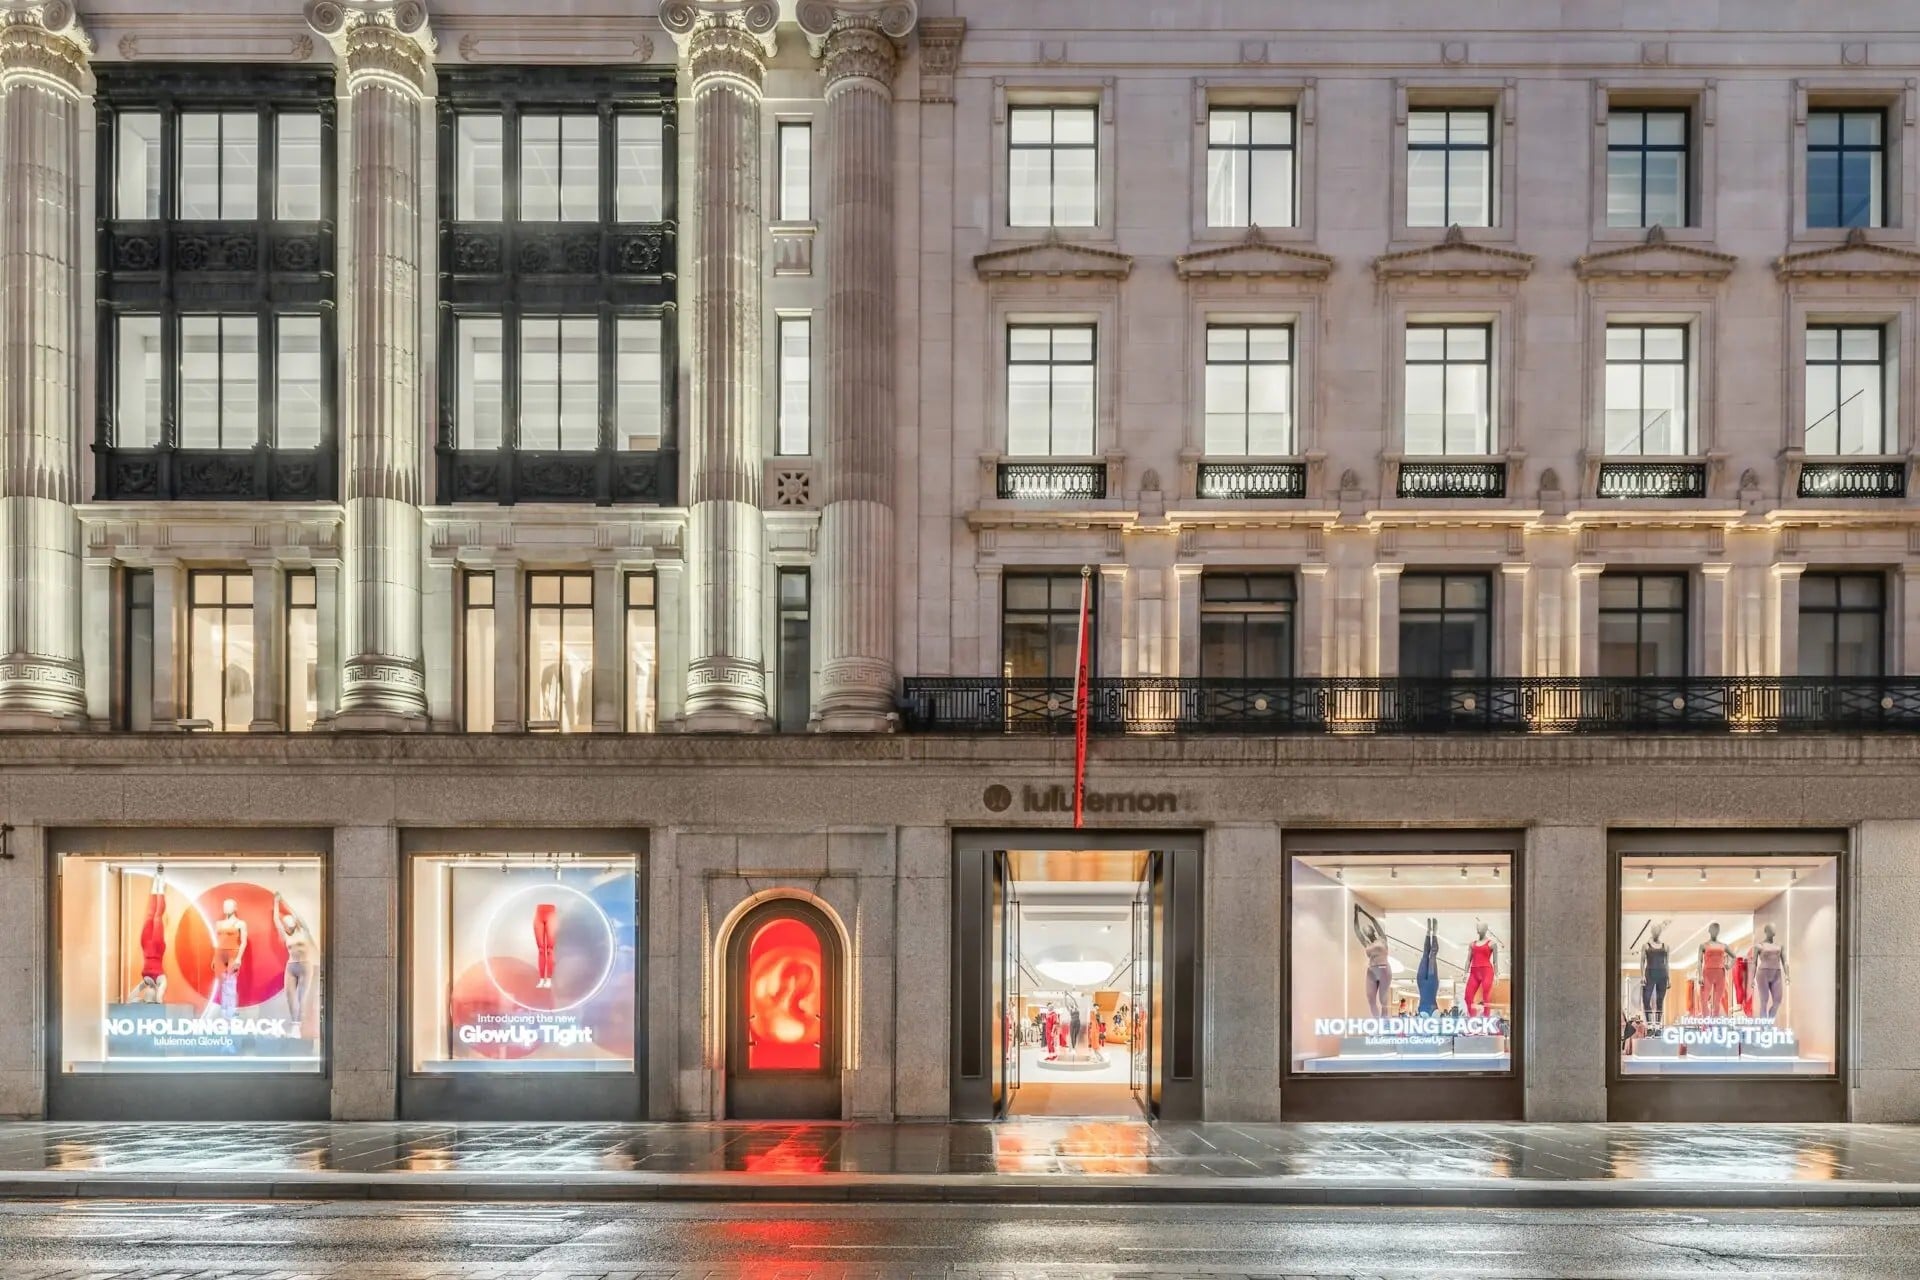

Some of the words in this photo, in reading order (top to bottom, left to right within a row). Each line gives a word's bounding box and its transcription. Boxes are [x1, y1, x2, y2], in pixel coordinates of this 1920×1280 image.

[1023, 785, 1177, 812] luluemon
[103, 1018, 135, 1036] NO
[137, 1018, 230, 1036] HOLDING
[230, 1018, 286, 1038] BACK
[478, 1014, 535, 1024] Introducing
[537, 1014, 553, 1023] the
[555, 1015, 576, 1023] new
[1314, 1018, 1346, 1036] NO
[1349, 1018, 1441, 1036] HOLDING
[1442, 1018, 1498, 1036] BACK
[1682, 1016, 1736, 1026] Introducing
[1737, 1016, 1753, 1025] the
[1755, 1017, 1775, 1025] new
[153, 1036, 197, 1046] lululemon
[198, 1036, 234, 1047] GlowUp
[459, 1025, 538, 1046] GlowUp
[540, 1025, 593, 1046] Tight
[1365, 1036, 1409, 1045] lululemon
[1409, 1036, 1445, 1046] GlowUp
[1662, 1027, 1741, 1048] GlowUp
[1742, 1027, 1794, 1048] Tight
